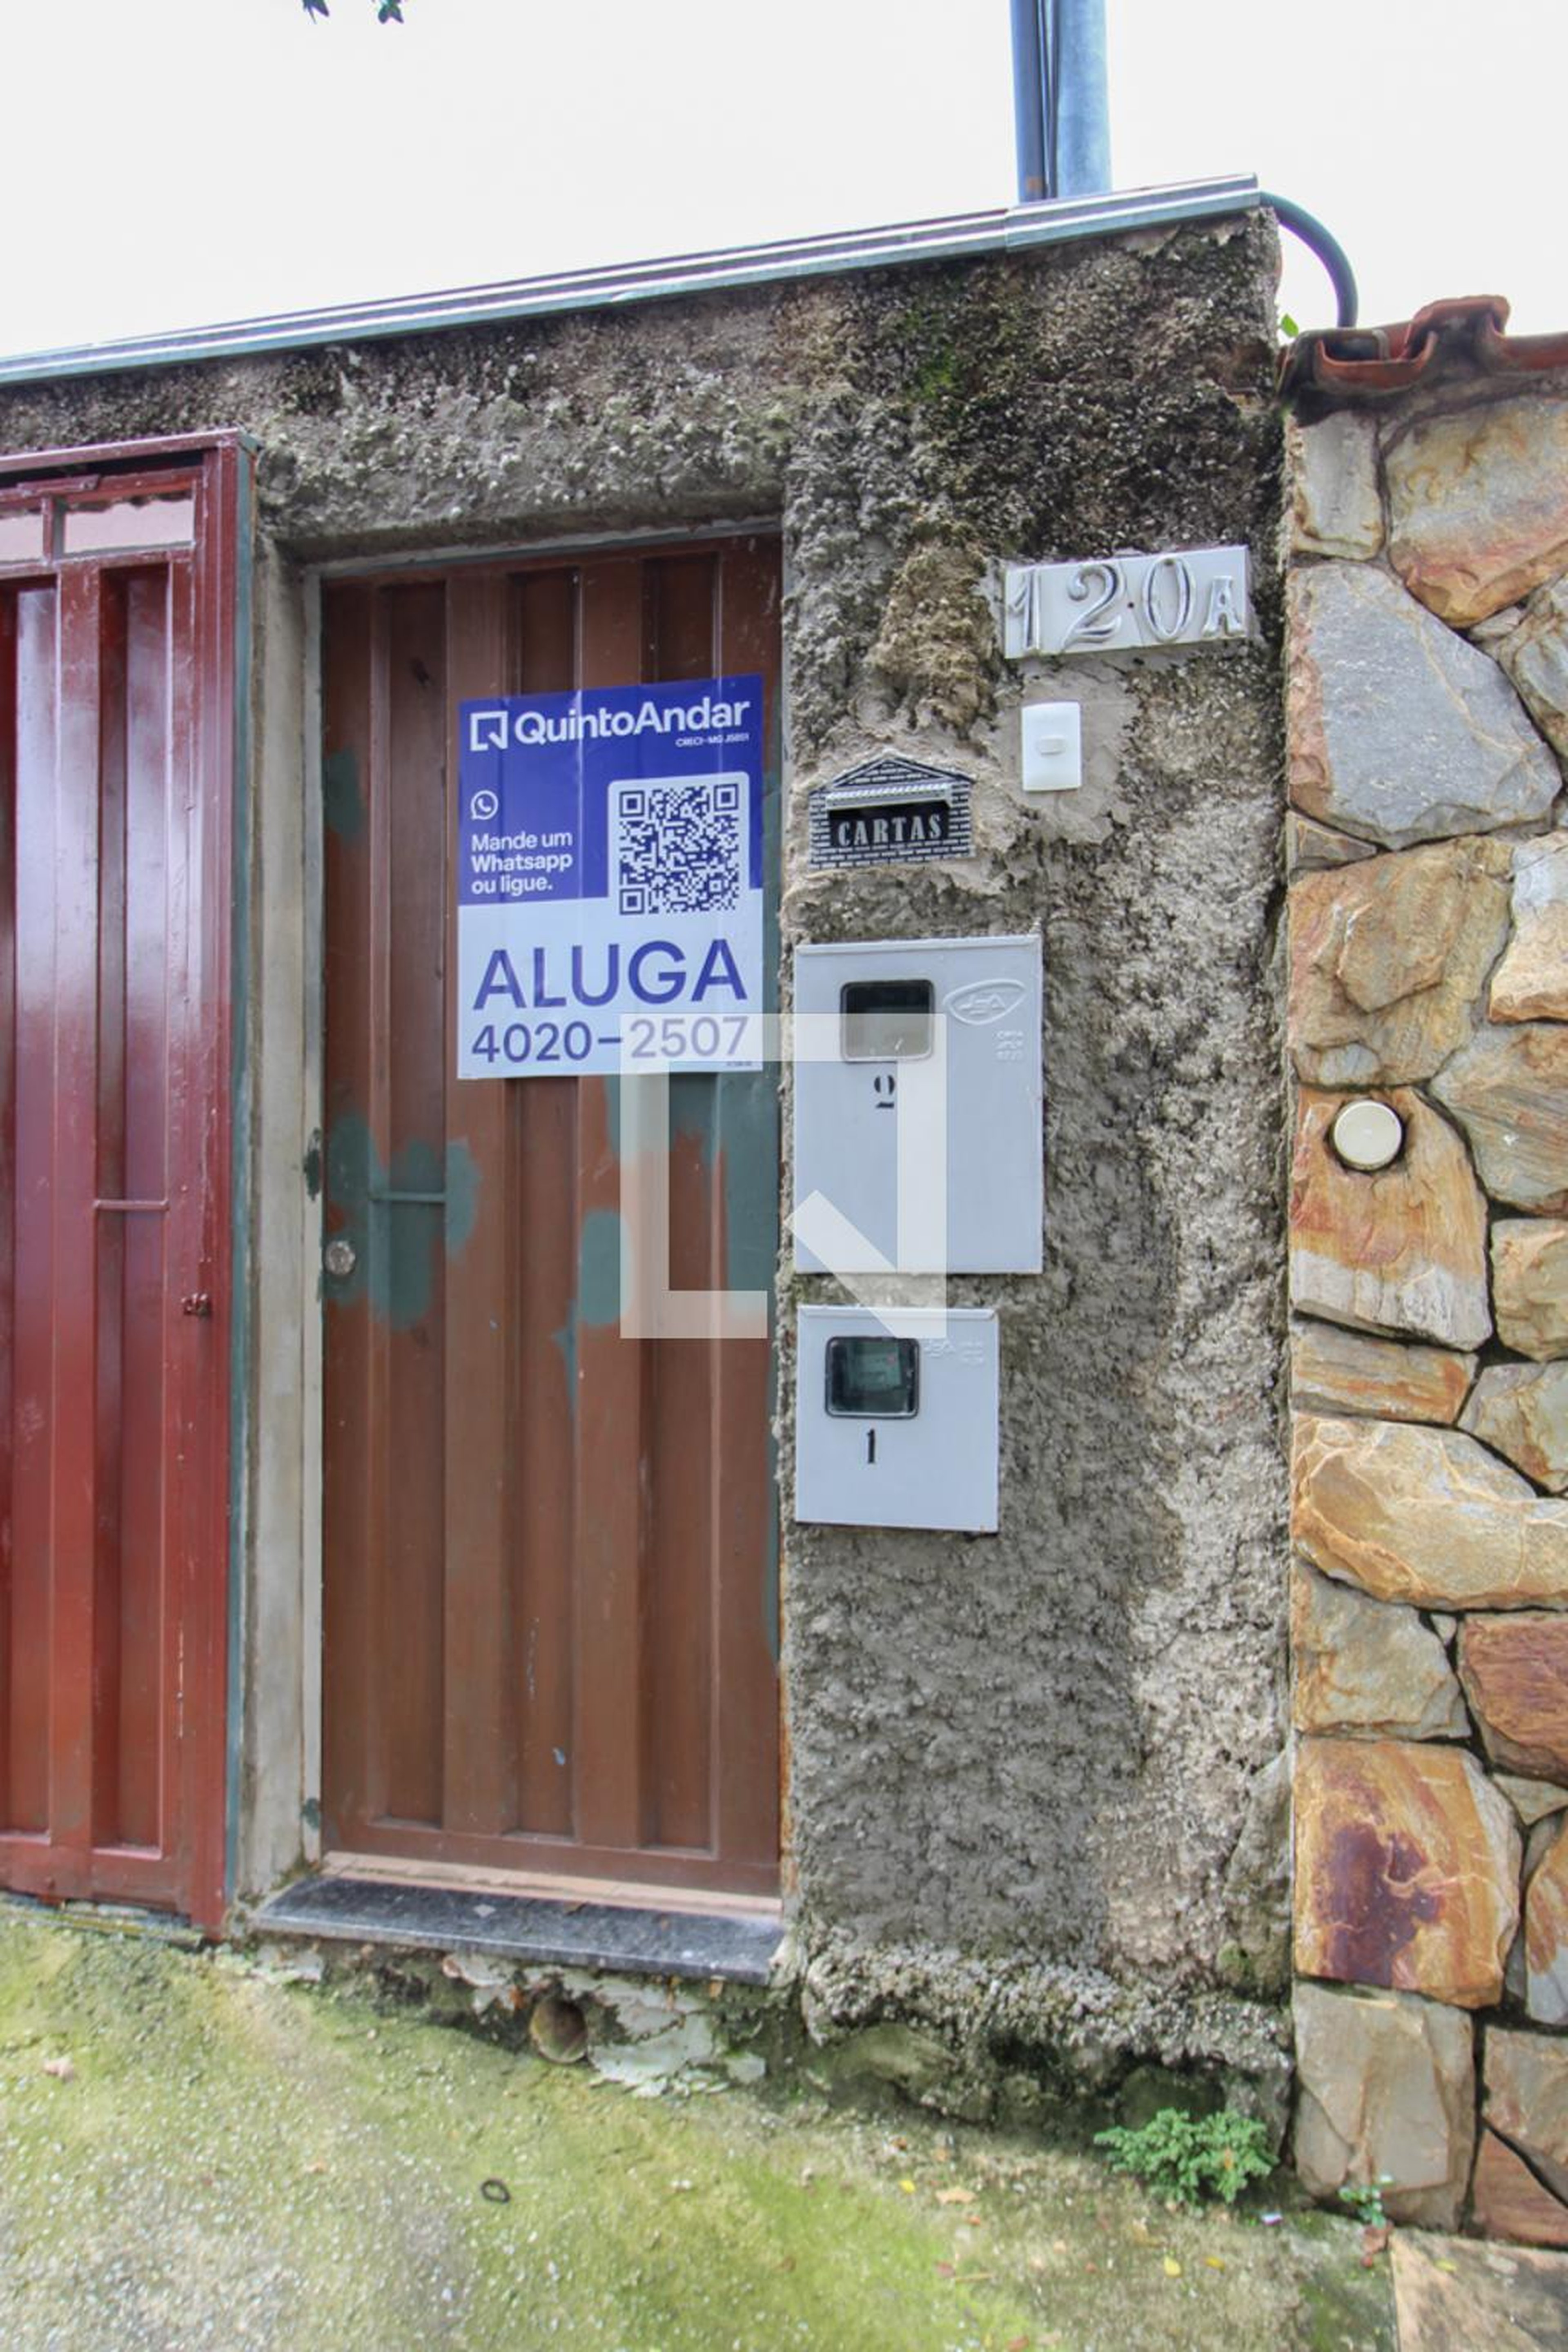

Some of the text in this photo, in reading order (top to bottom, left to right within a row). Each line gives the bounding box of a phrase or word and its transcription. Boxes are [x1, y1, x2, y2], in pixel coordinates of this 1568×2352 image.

[514, 697, 751, 745] QuintoAndar
[472, 831, 572, 852] Mande um
[838, 814, 941, 846] CARTAS
[472, 853, 573, 873] Whatsapp
[472, 874, 552, 896] ou ligue.
[472, 938, 748, 1011] ALUGA
[472, 1016, 749, 1063] 4020-2507
[866, 1428, 876, 1464] 1
